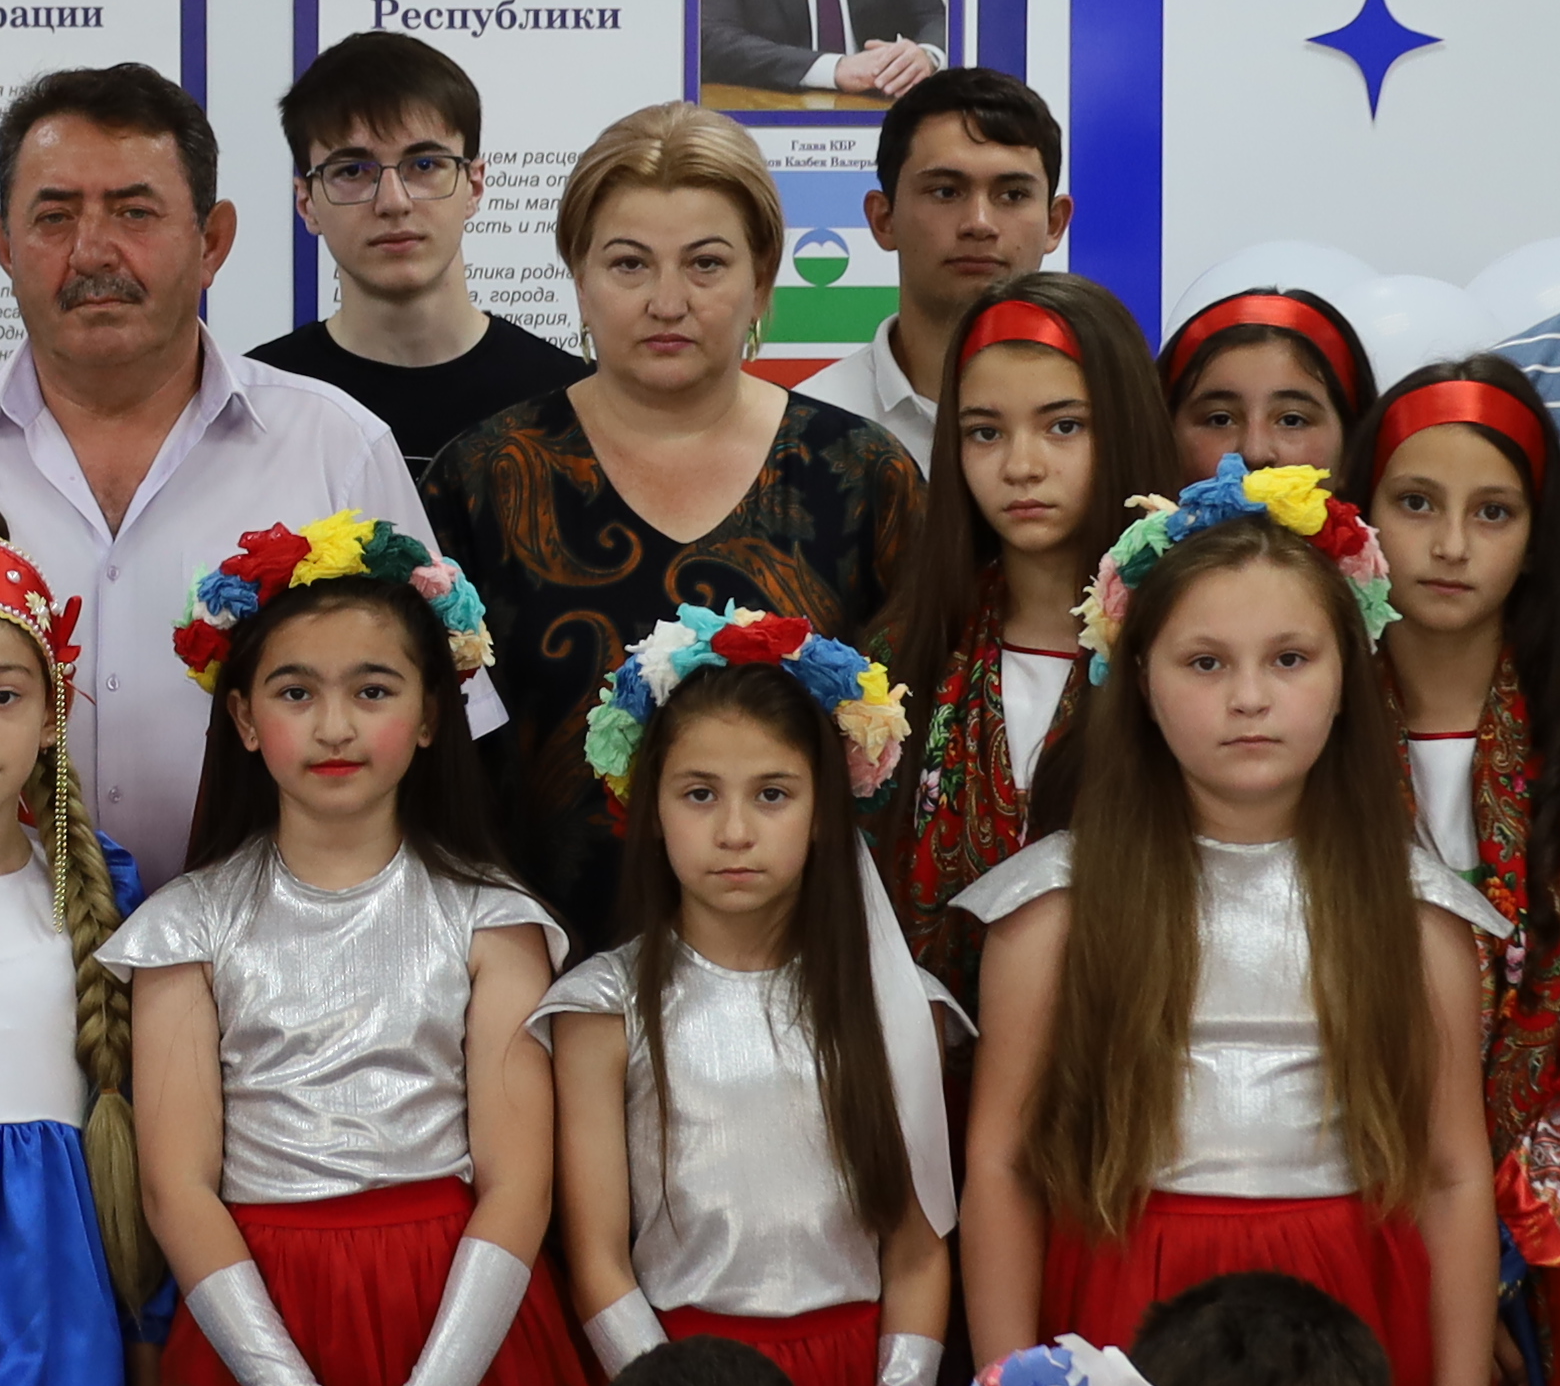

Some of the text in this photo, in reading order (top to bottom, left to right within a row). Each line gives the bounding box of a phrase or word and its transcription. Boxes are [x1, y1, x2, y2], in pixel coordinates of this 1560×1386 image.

[791, 140, 856, 151] Глава КБР
[785, 156, 827, 168] Казбек
[484, 171, 541, 187] одина
[487, 198, 520, 211] ты
[464, 221, 512, 234] ость
[518, 221, 530, 234] и
[464, 263, 516, 280] блика
[489, 286, 560, 307] города.
